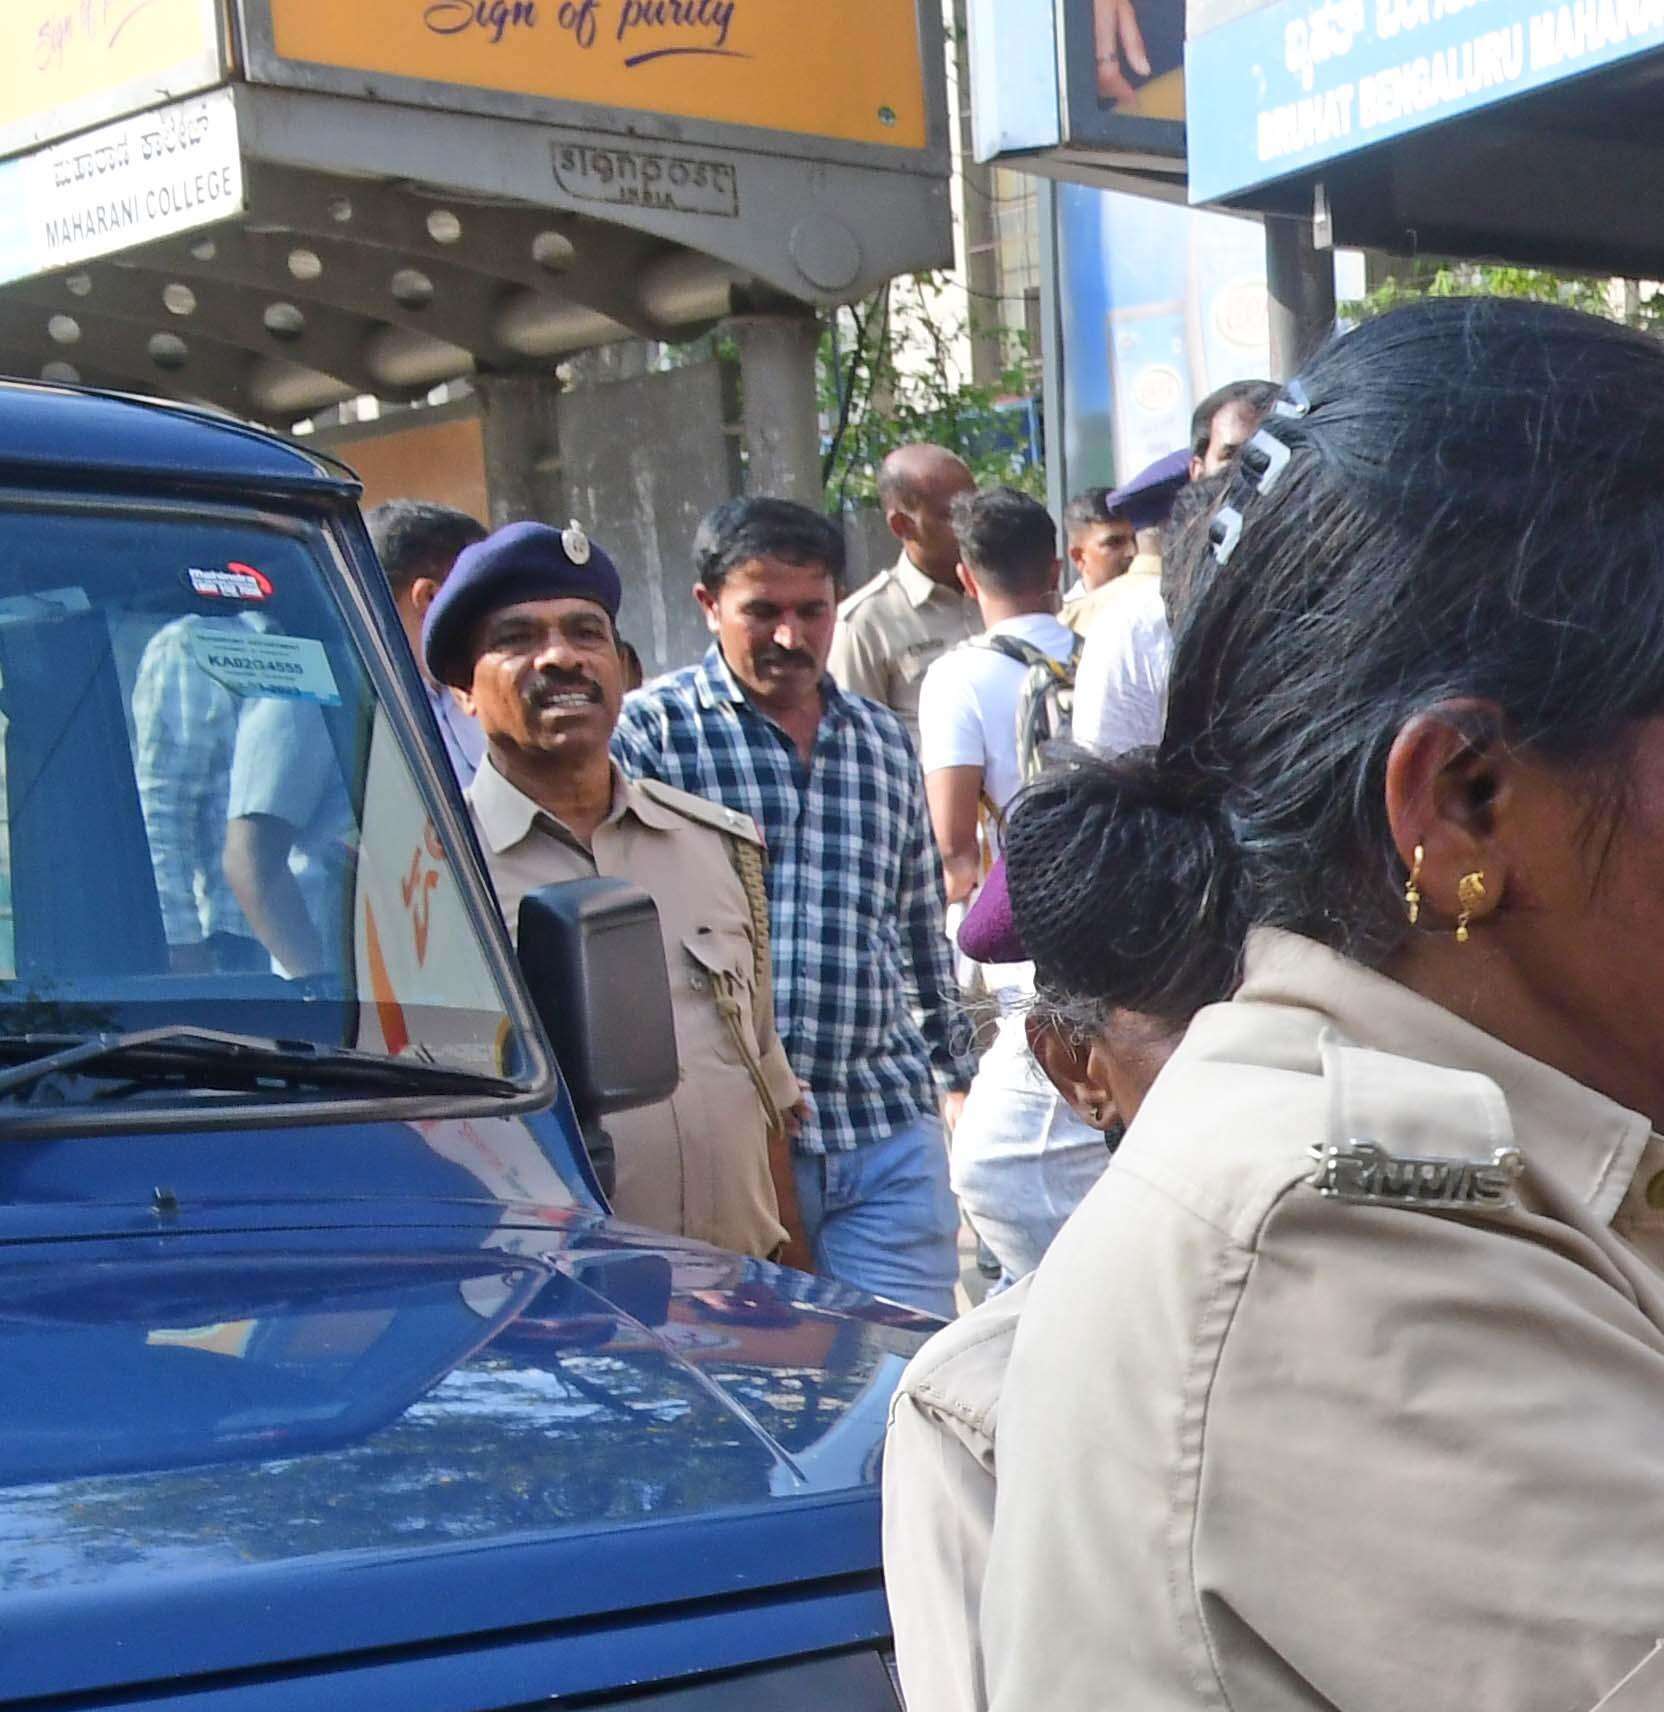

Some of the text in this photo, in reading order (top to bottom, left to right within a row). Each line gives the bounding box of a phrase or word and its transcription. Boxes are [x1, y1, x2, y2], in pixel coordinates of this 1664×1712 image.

[558, 0, 597, 48] of
[1358, 24, 1525, 129] BENGALURU
[45, 166, 233, 249] MAHARANI COLLEGE
[207, 653, 304, 675] KA02G4555
